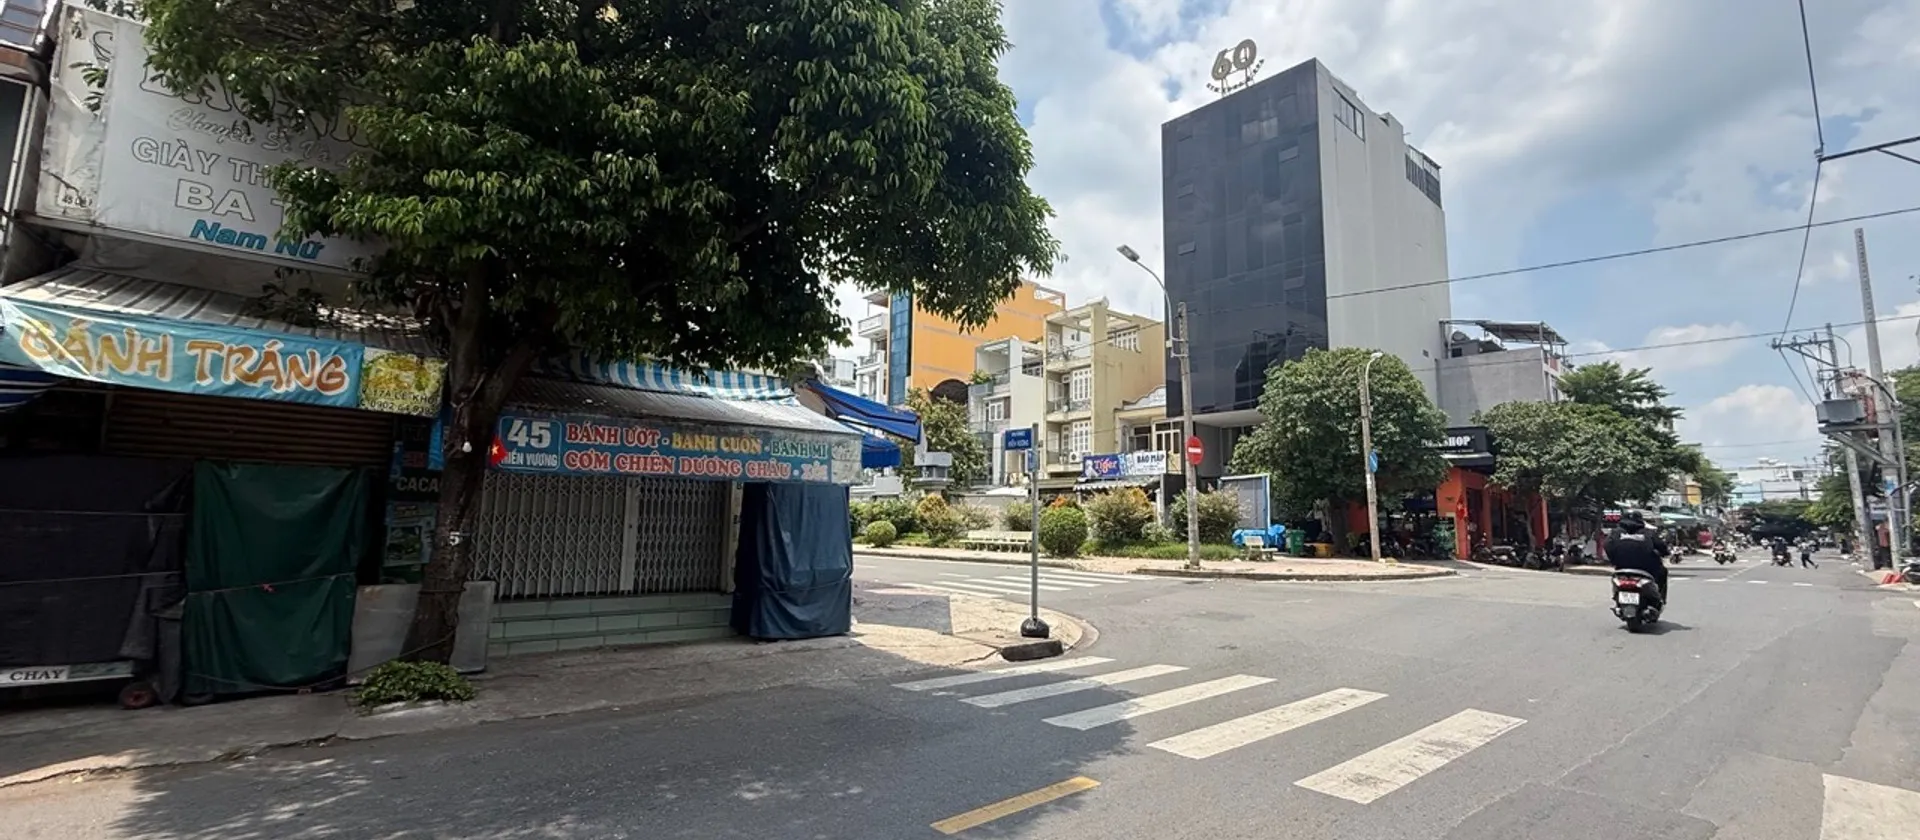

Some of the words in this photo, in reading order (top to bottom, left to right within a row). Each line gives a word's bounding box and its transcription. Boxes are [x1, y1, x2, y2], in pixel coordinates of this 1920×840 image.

[1211, 39, 1257, 81] 60
[131, 136, 221, 176] GIÀY
[228, 157, 276, 190] TH
[175, 178, 255, 222] BA
[189, 218, 268, 251] Nam
[19, 318, 172, 383] BÁNH
[186, 338, 350, 396] TRÁNG
[507, 419, 551, 449] 45
[565, 420, 621, 444] BÁNH
[564, 449, 611, 471] CƠM
[614, 451, 676, 473] CHIÊN
[679, 454, 743, 477] DƯƠNG
[746, 458, 792, 479] CHÂU
[1094, 458, 1117, 473] Tiger
[396, 477, 440, 493] CACA
[10, 669, 66, 681] CHAY
